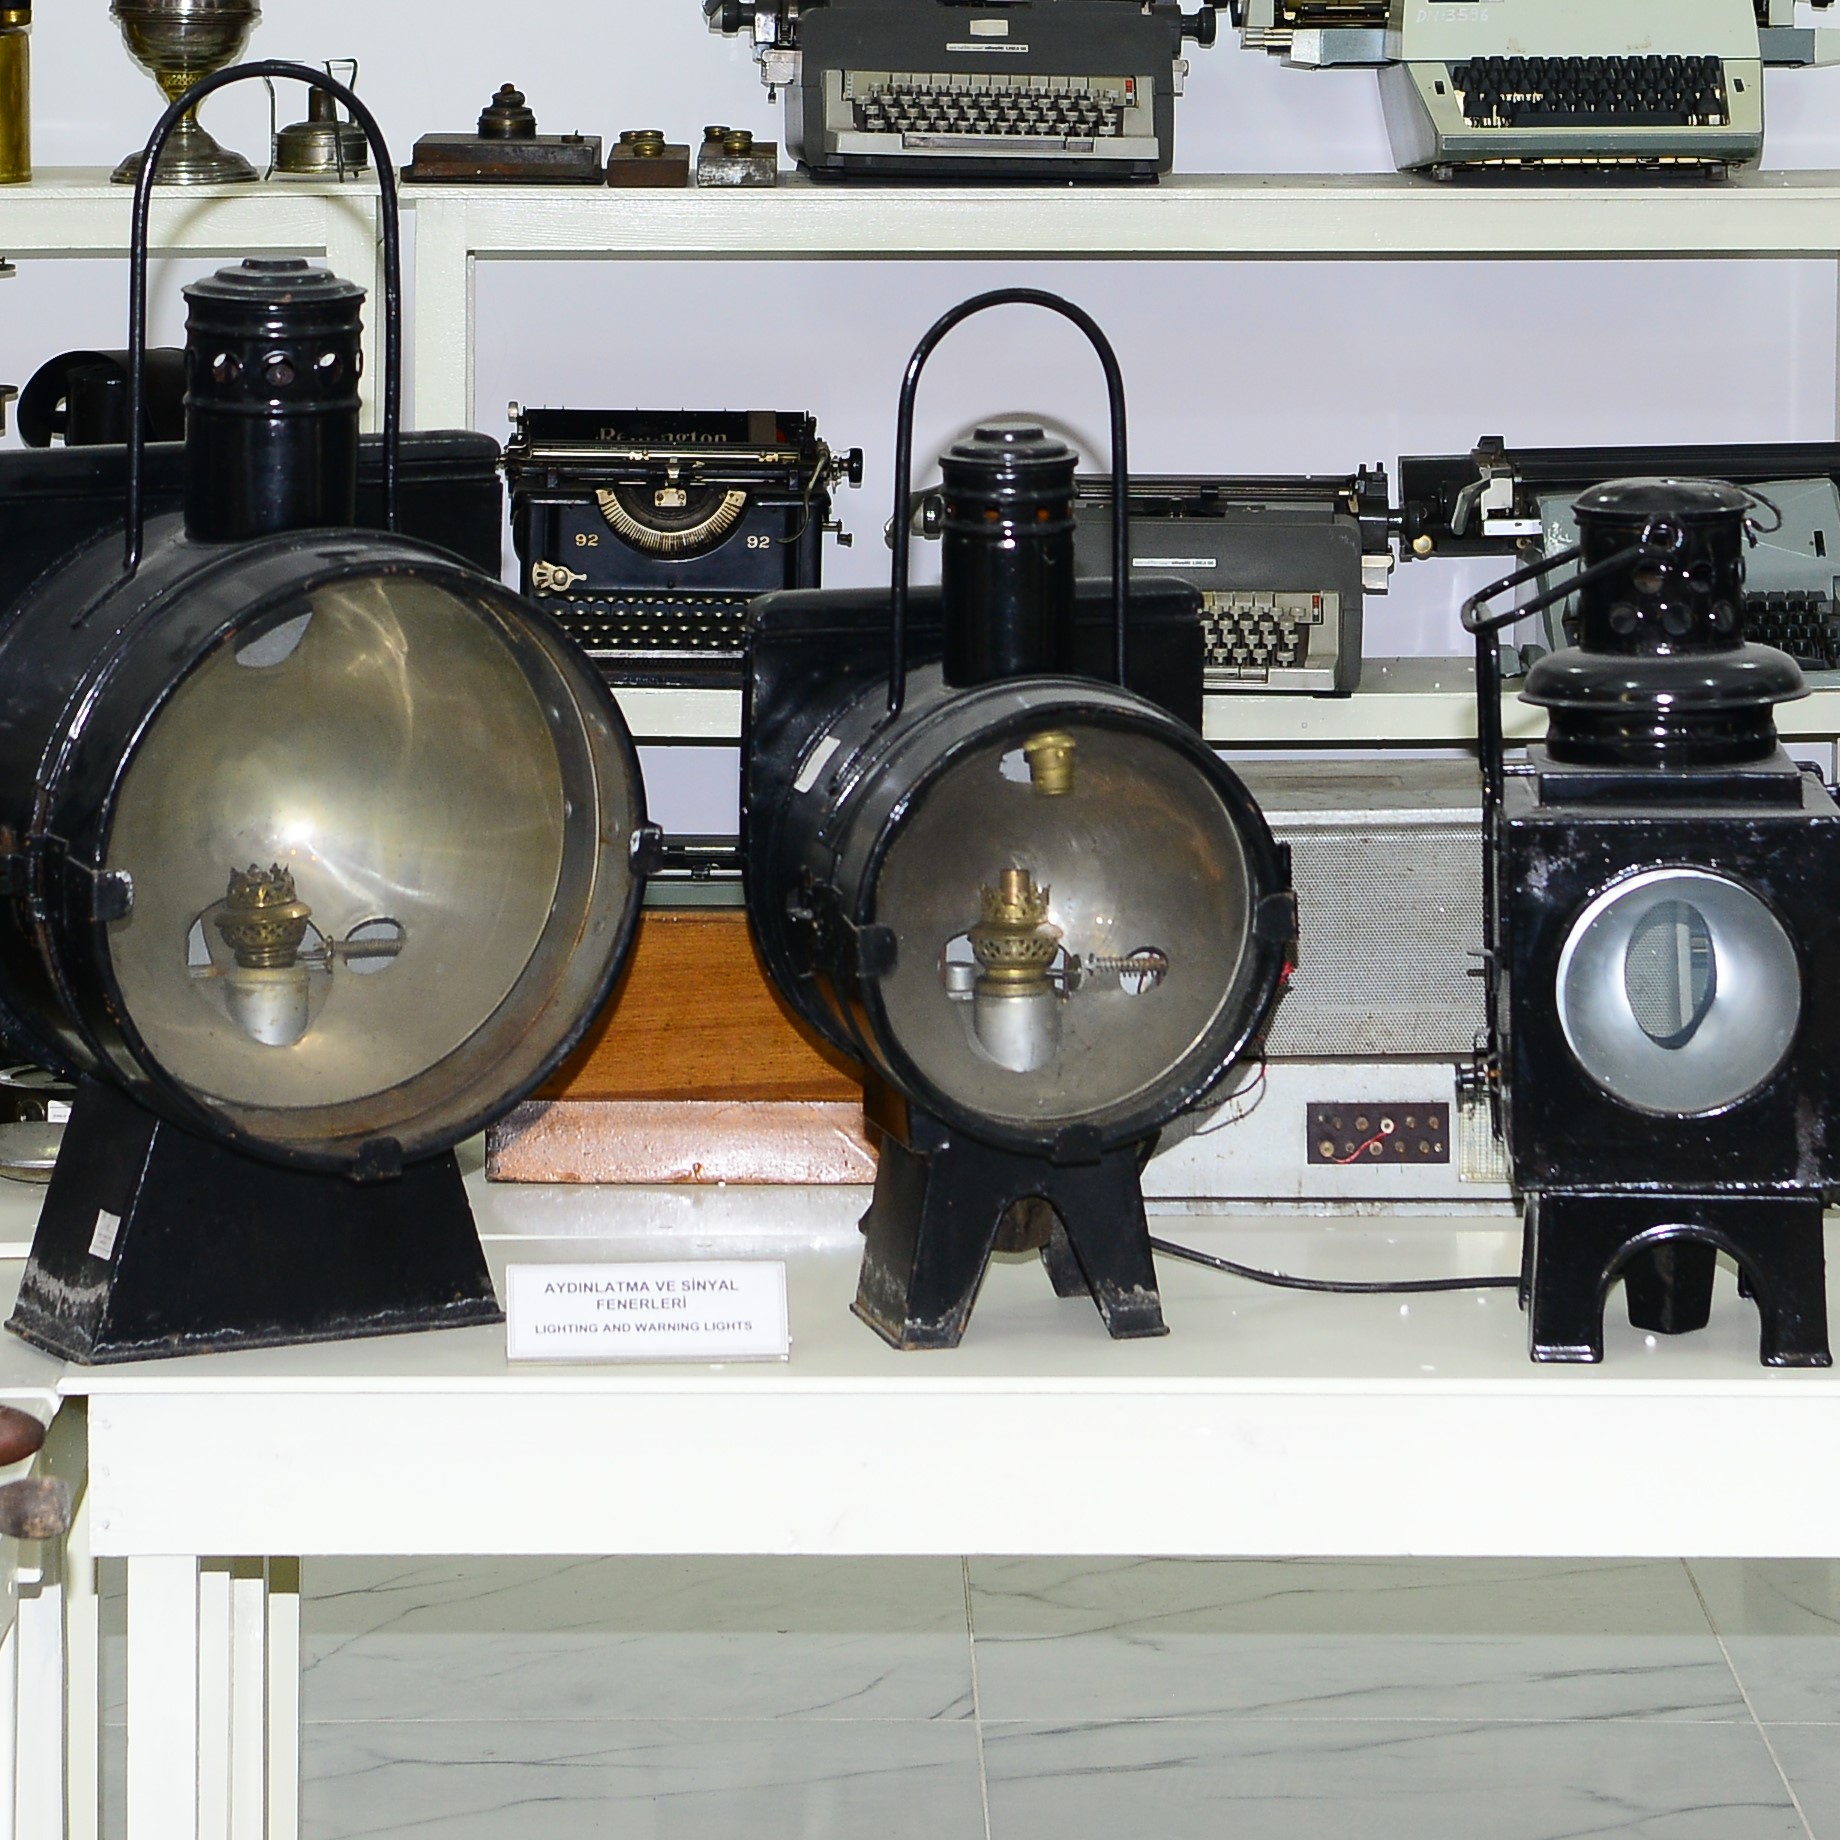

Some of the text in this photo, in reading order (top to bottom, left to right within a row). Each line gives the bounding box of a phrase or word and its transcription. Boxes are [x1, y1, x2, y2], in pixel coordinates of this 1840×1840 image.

[600, 427, 727, 442] Rengton
[575, 534, 599, 547] 92
[747, 536, 770, 548] 92
[544, 1277, 740, 1294] AYDINLATMA VE SİNYAL
[596, 1295, 688, 1310] FENERLERİ
[535, 1320, 754, 1335] LIGHTING AND WARNING LIGHTS
